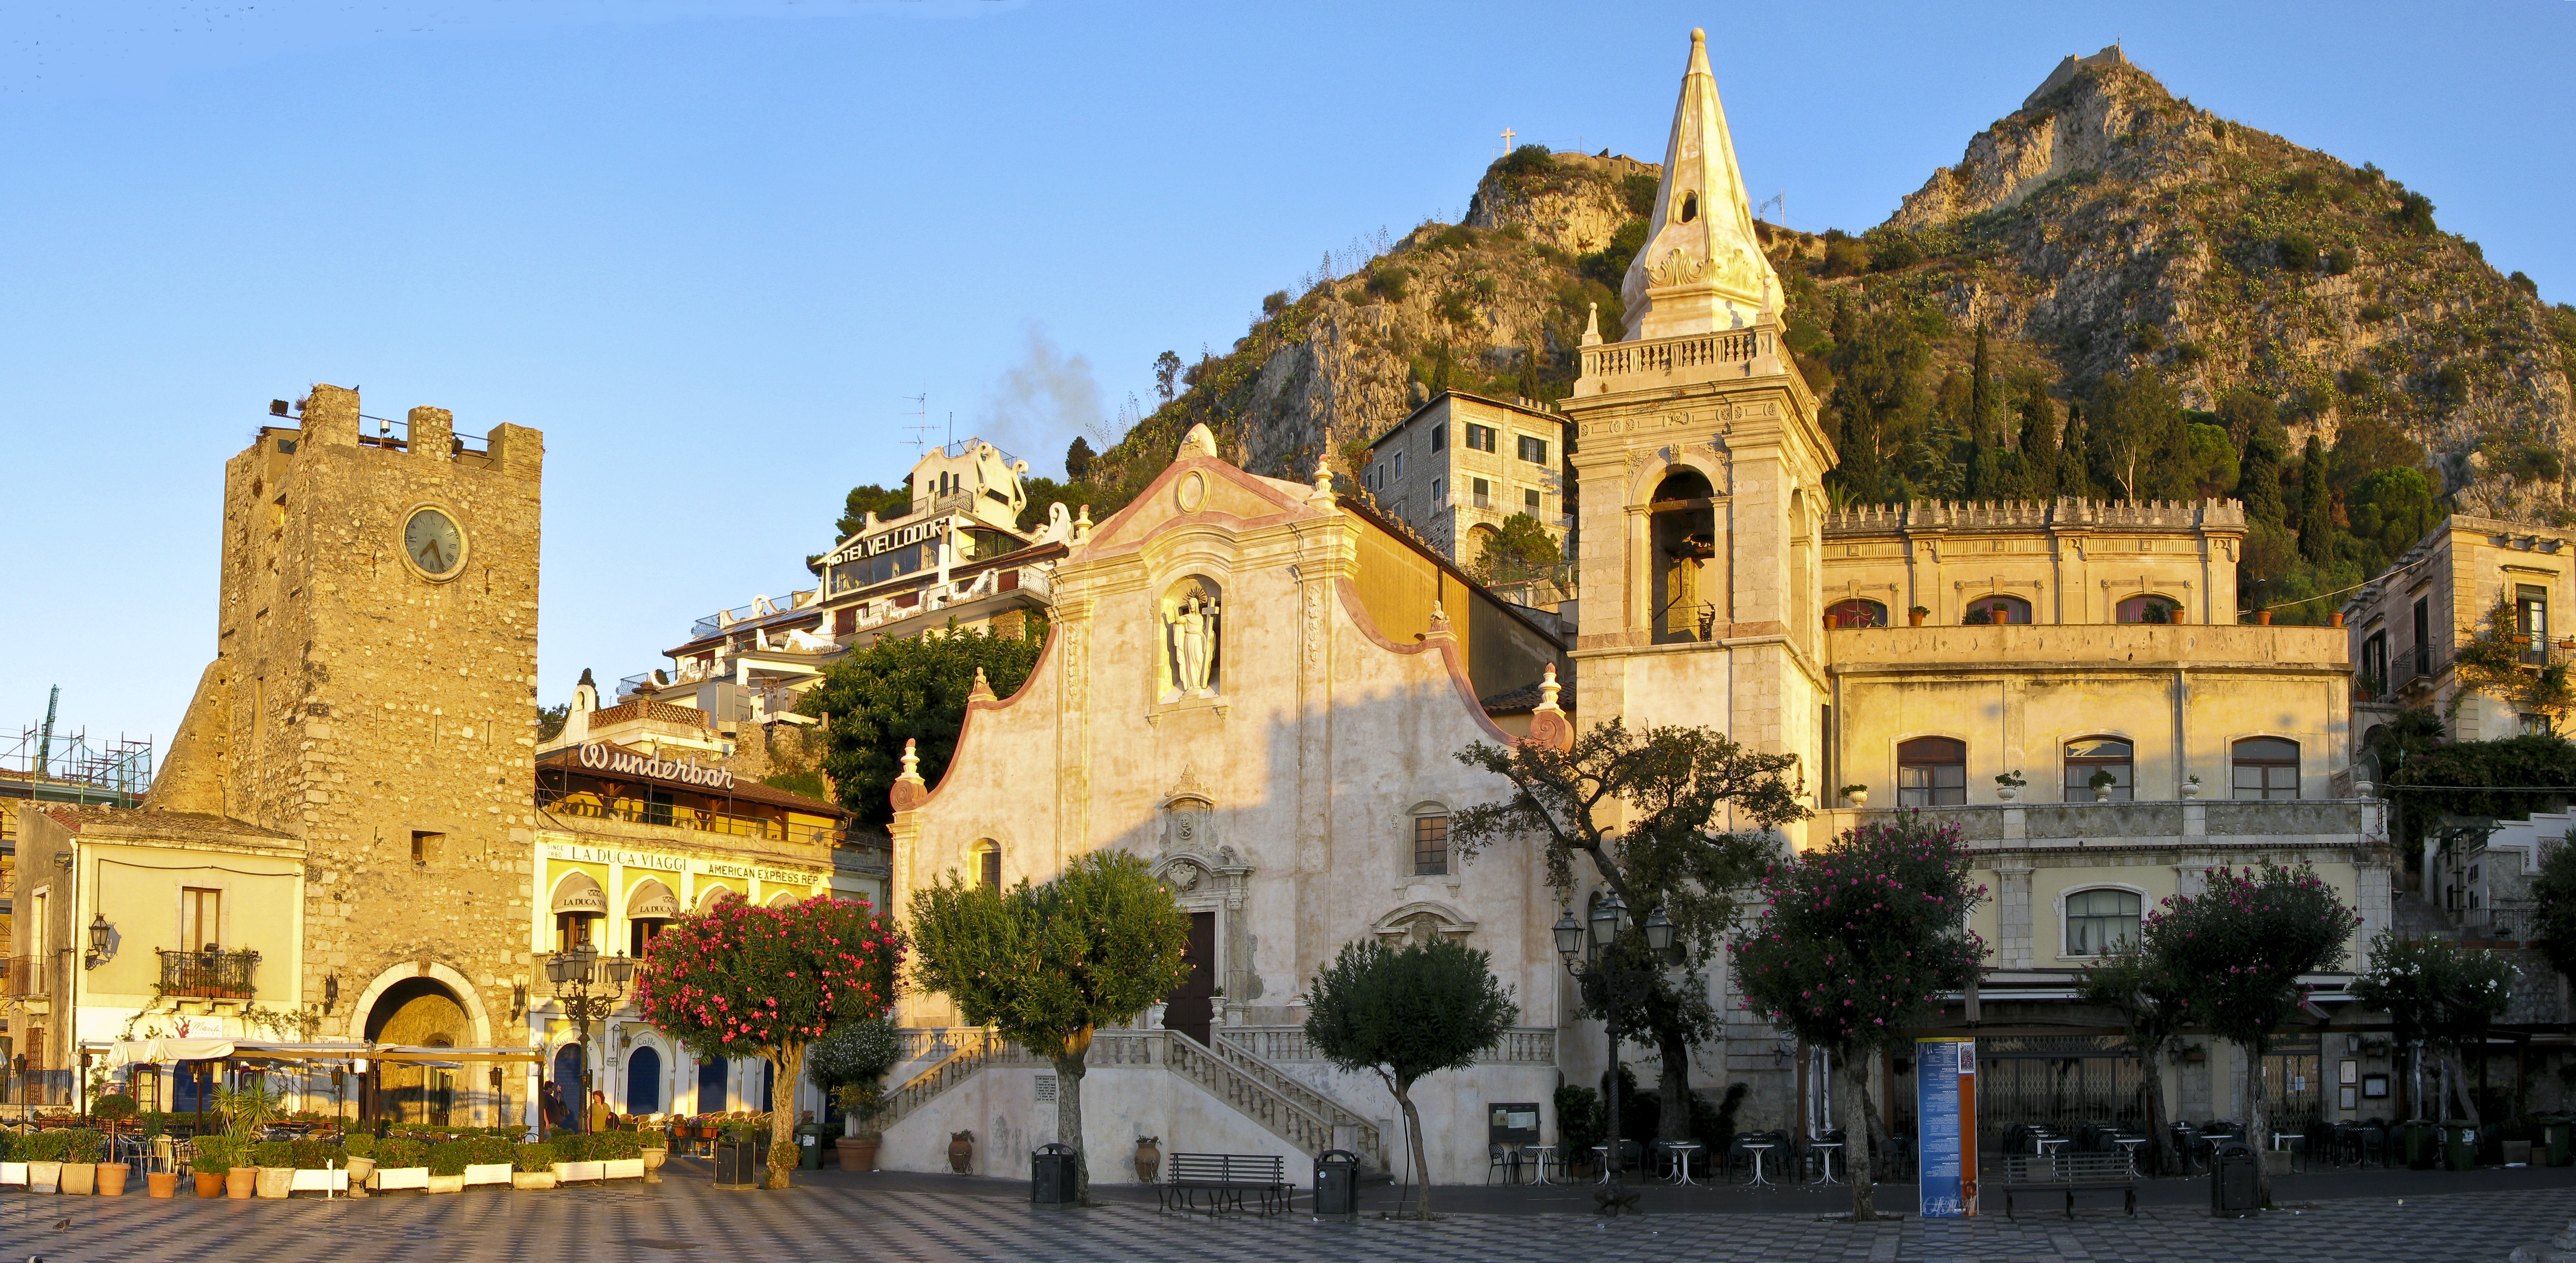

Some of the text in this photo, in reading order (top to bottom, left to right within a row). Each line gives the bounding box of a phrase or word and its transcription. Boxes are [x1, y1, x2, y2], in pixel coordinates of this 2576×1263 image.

[827, 544, 867, 567] HOTEL
[579, 741, 735, 789] Wunderbar
[572, 846, 686, 871] LA DUCA VIAGGI
[708, 864, 755, 878] AMERICAN
[758, 869, 799, 883] EXPRESS
